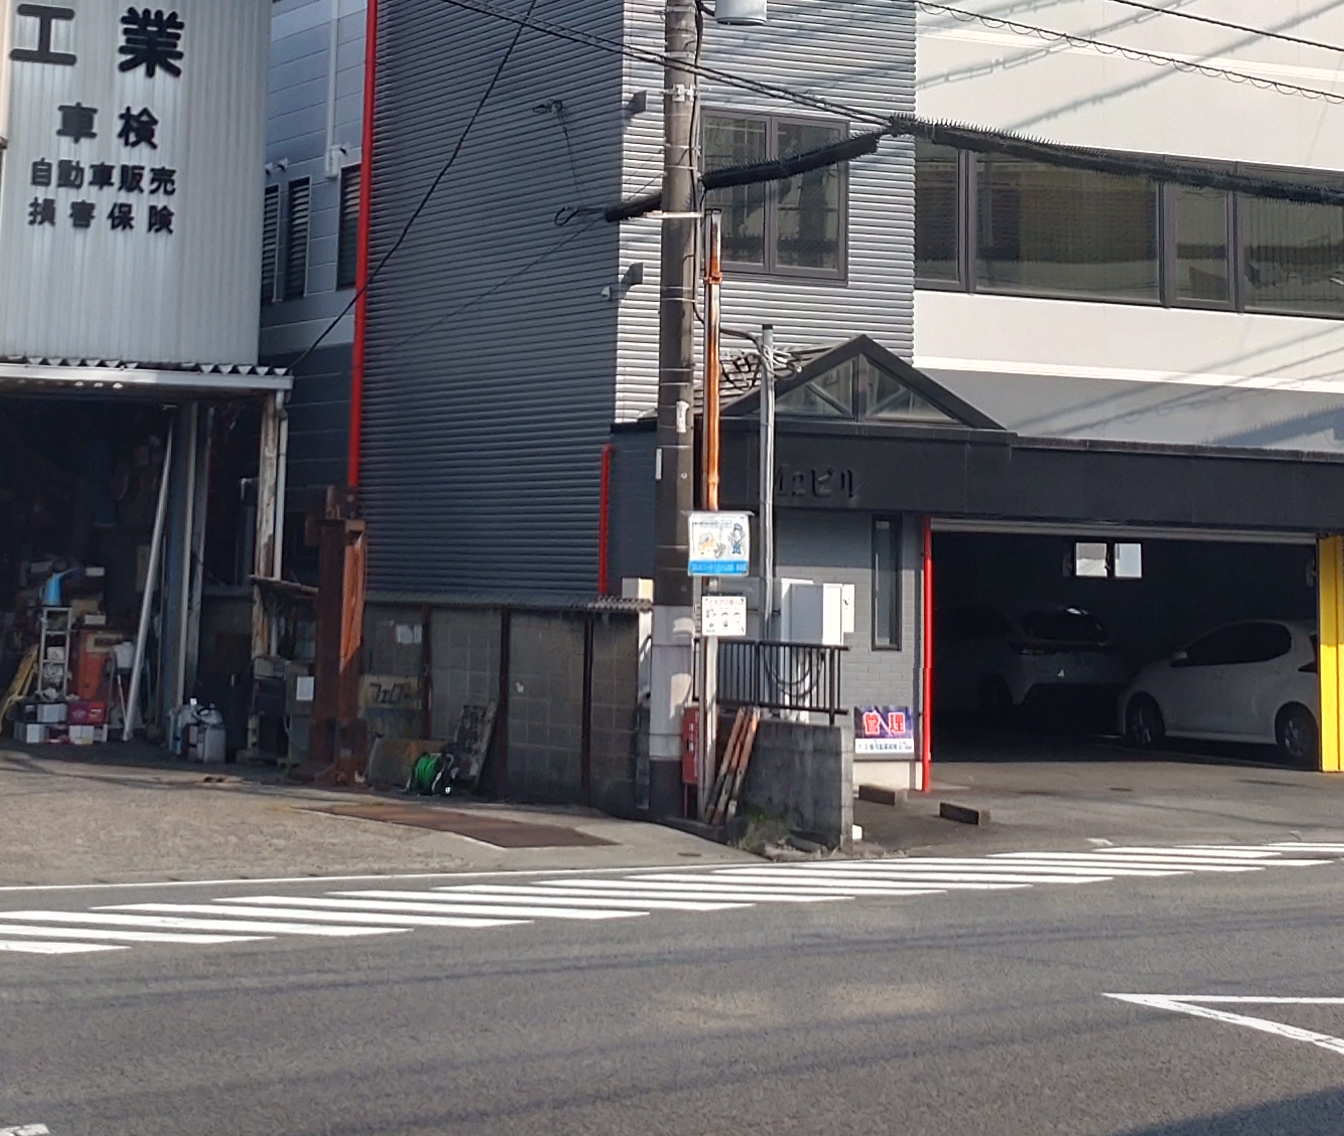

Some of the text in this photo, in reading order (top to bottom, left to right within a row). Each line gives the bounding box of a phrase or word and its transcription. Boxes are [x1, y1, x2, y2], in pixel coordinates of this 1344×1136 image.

[56, 101, 158, 149] 車検
[30, 157, 177, 196] 自動車販売
[28, 196, 175, 234] 損害保険
